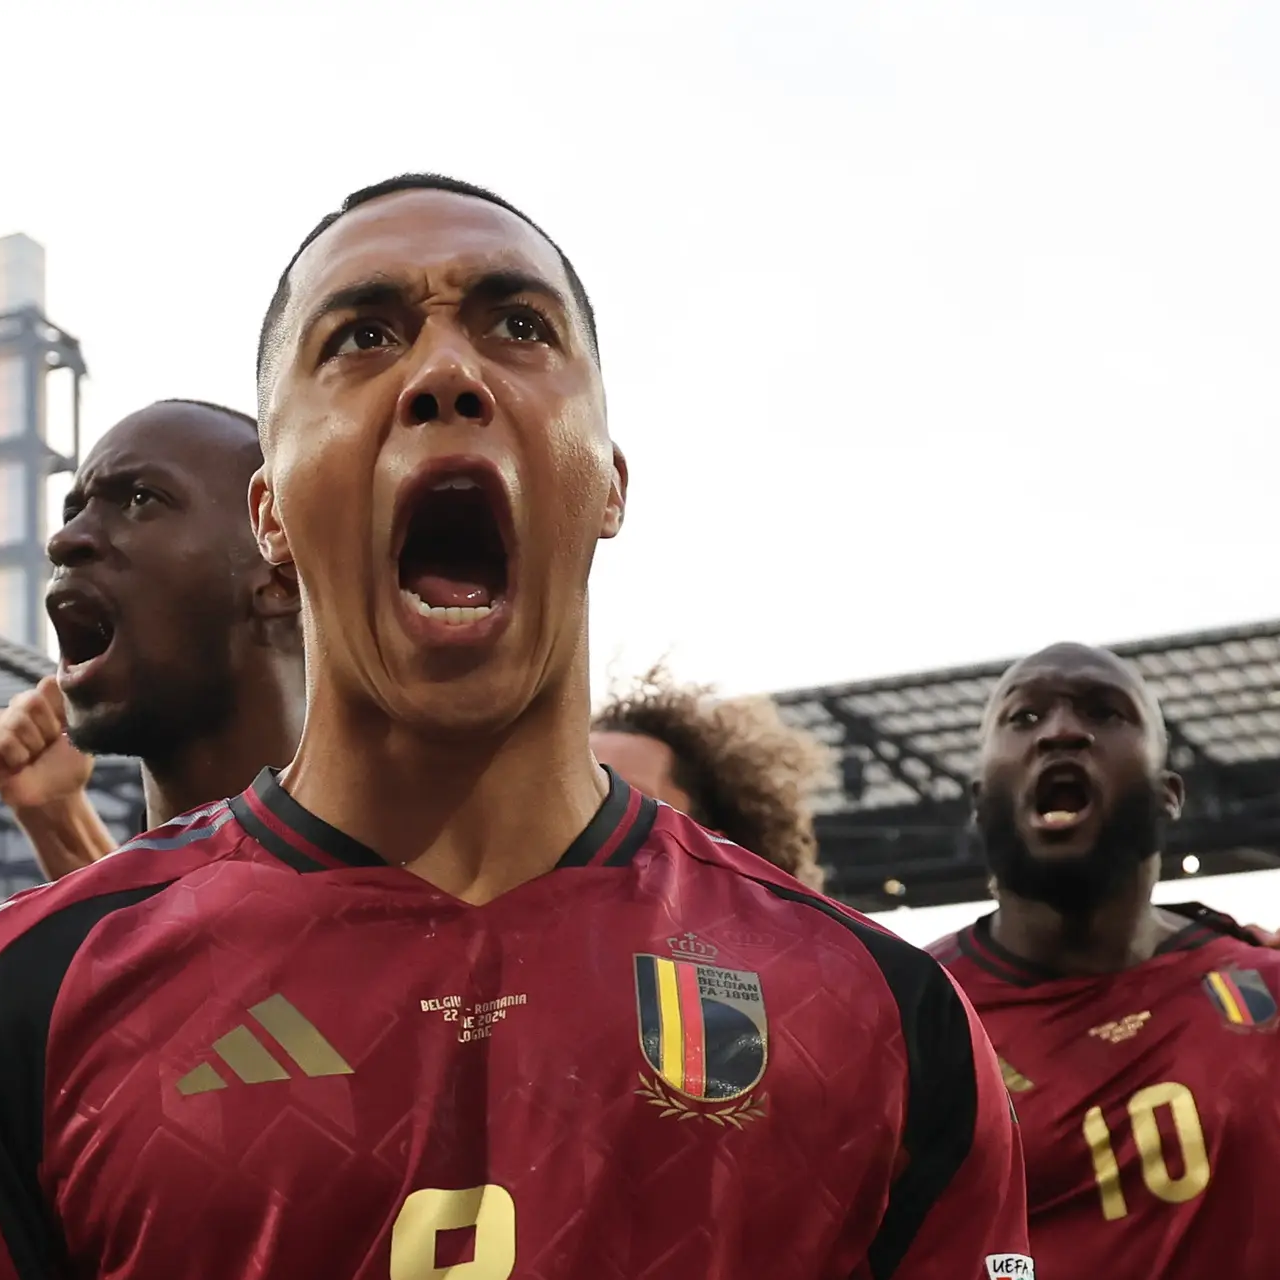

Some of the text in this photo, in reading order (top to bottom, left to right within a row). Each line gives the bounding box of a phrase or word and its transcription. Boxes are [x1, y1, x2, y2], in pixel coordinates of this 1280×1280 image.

[697, 967, 742, 981] ROYAL
[698, 977, 759, 992] BELGIAN
[420, 995, 462, 1012] BELGIU
[474, 993, 528, 1015] ROMANIA
[442, 1008, 459, 1022] 22
[478, 1009, 507, 1027] 2024
[1082, 1081, 1211, 1221] 10
[992, 1257, 1029, 1275] UEFA
